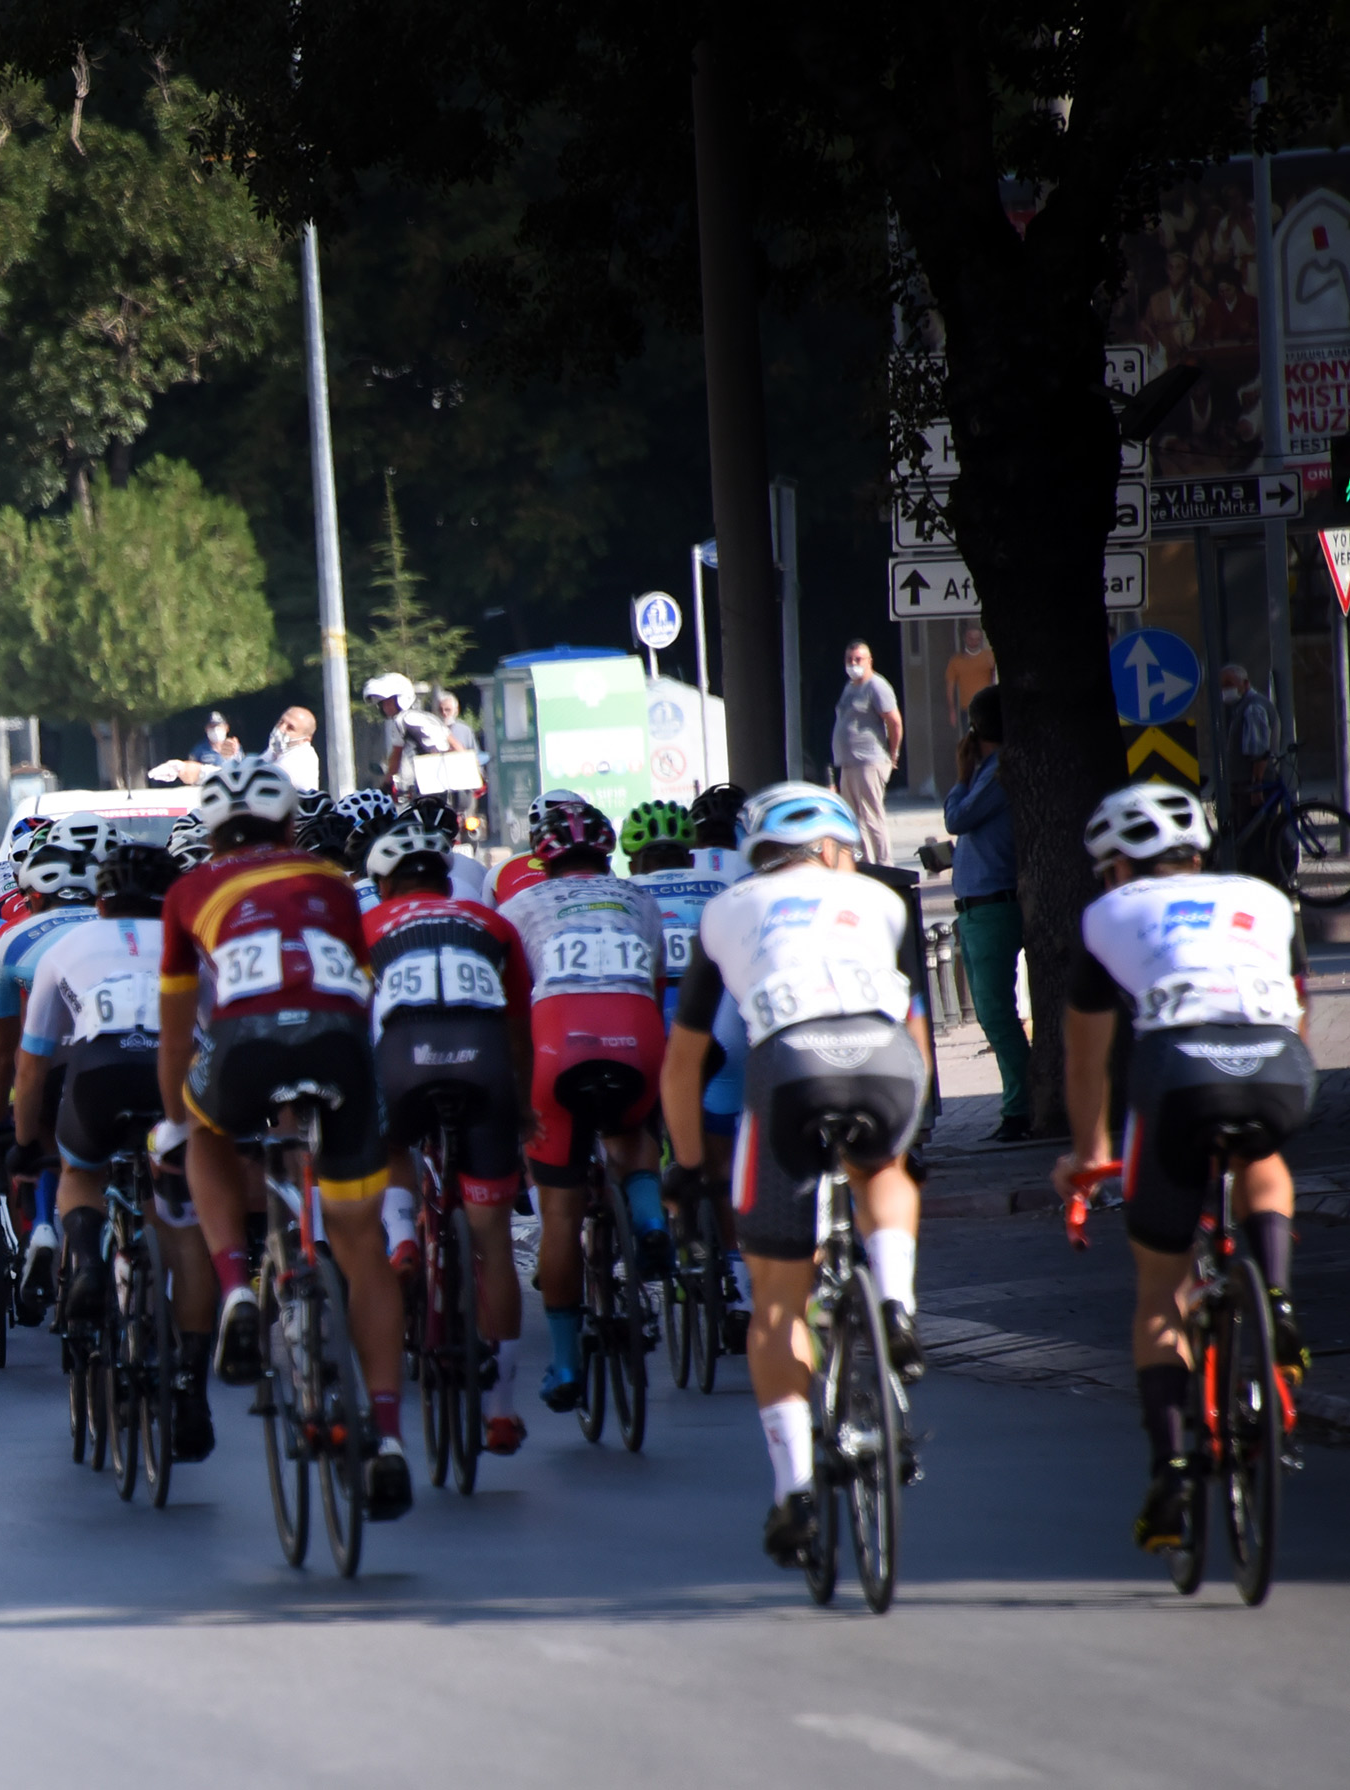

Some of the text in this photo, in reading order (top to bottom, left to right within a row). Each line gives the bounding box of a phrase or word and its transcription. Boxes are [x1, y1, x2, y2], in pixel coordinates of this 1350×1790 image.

[554, 940, 650, 972] 12 12
[388, 963, 494, 1001] 95 95
[95, 989, 114, 1024] 6
[600, 1036, 637, 1046] TOTO
